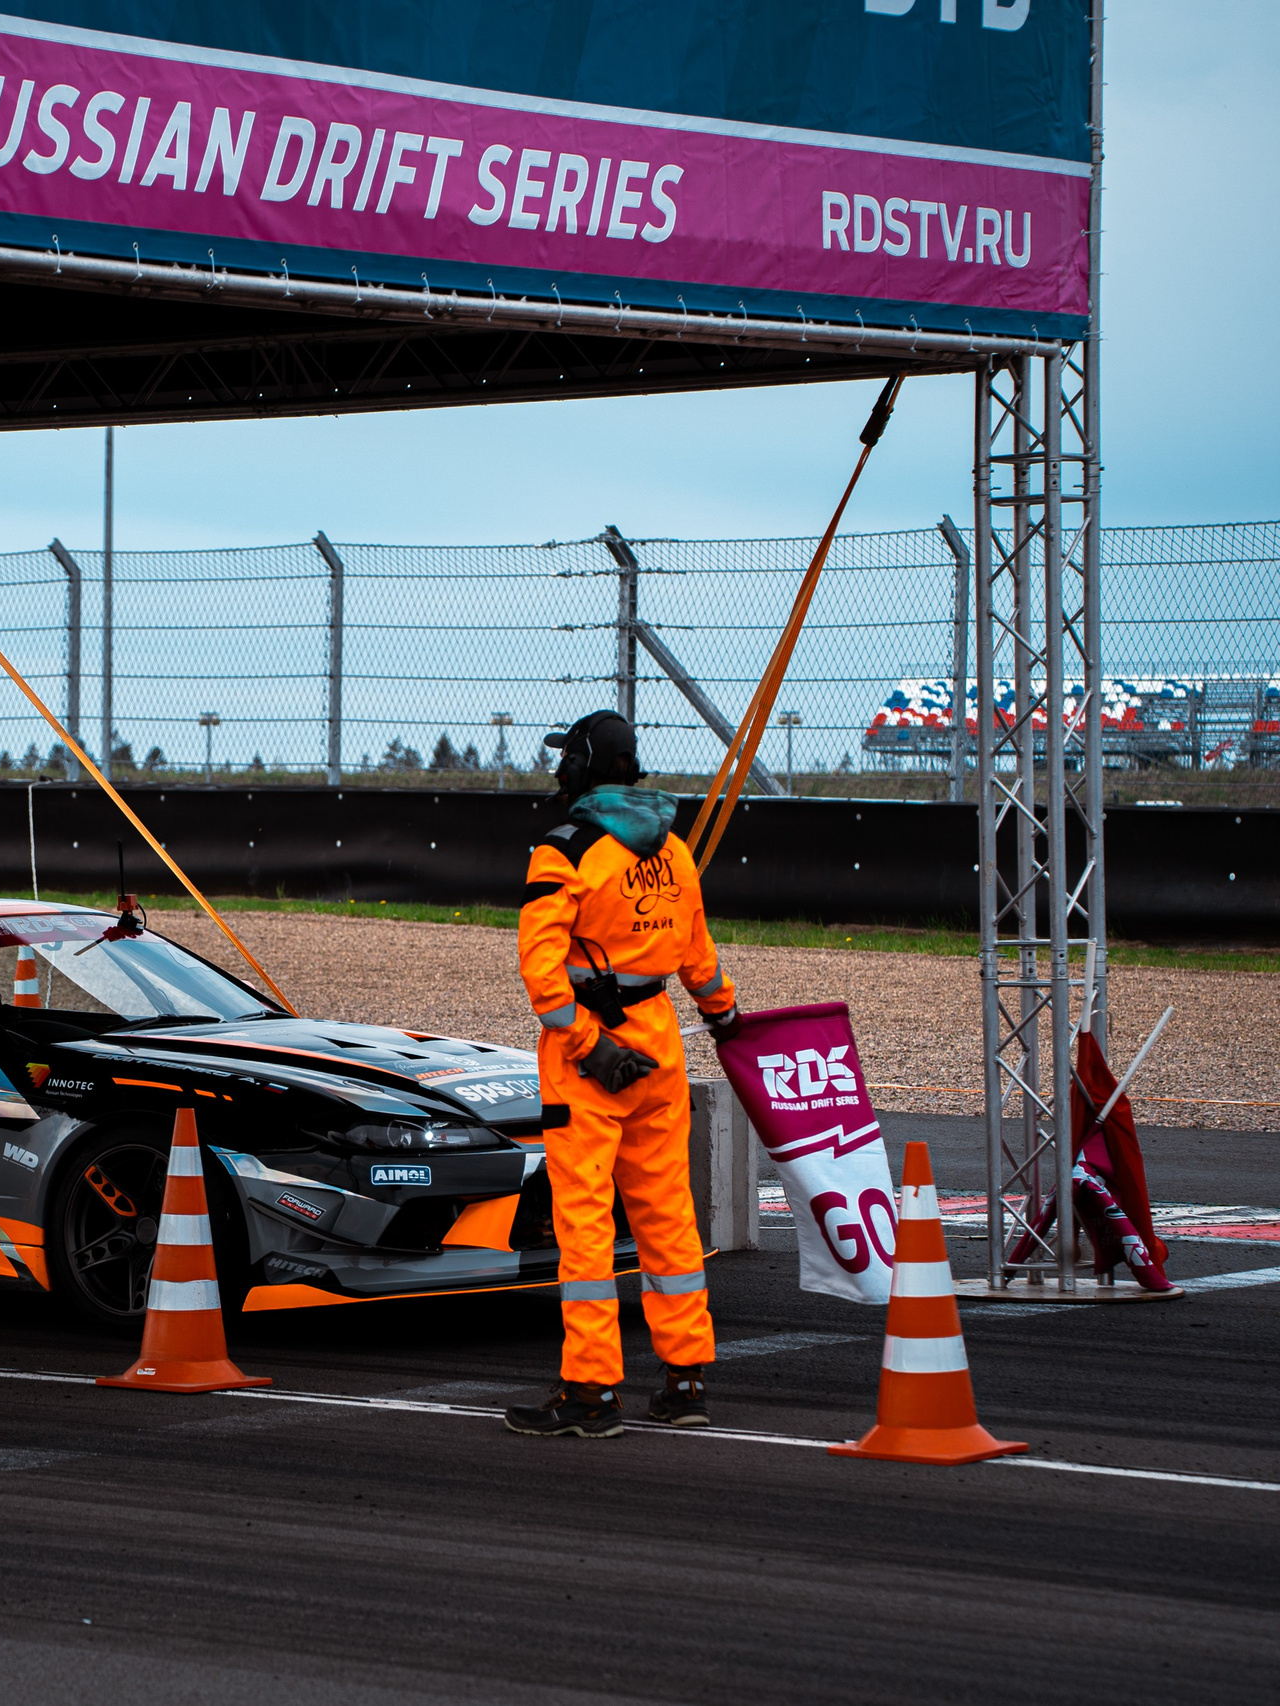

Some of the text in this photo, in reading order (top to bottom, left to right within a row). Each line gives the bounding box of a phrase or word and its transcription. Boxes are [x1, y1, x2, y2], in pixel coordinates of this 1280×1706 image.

[260, 115, 464, 220] DRIFT
[468, 143, 684, 244] SERIES
[822, 190, 1031, 268] RDSTV.RU
[415, 1067, 465, 1080] HITECH
[757, 1045, 857, 1099] RDS
[48, 1078, 94, 1091] INNOTEC
[454, 1075, 541, 1105] spsgro
[771, 1100, 808, 1111] RUSSIAN
[811, 1097, 834, 1109] DRIFT
[374, 1169, 429, 1182] AIMOL
[280, 1199, 318, 1219] RACING
[282, 1193, 322, 1216] FORWARD
[809, 1187, 898, 1274] GO
[267, 1257, 327, 1279] HITECH
